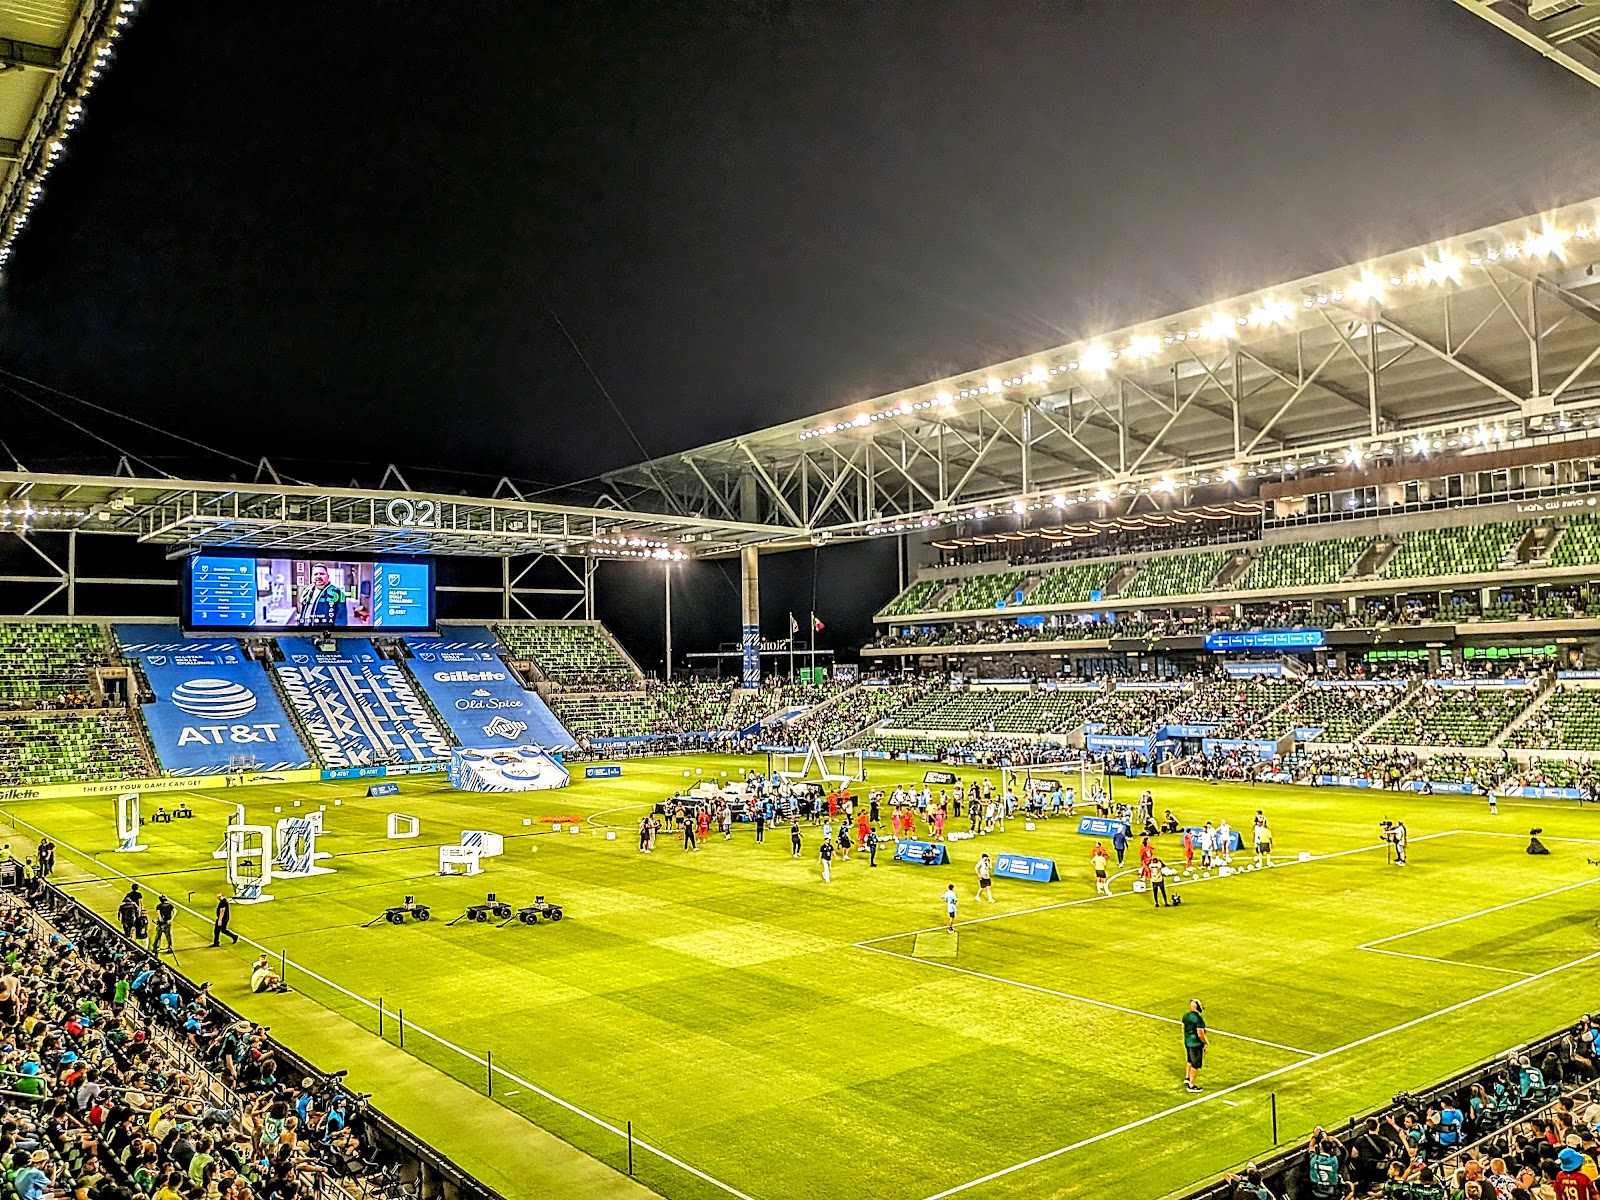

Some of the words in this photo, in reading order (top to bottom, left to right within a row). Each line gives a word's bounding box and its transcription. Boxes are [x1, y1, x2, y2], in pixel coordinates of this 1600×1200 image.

[386, 498, 434, 526] Q2
[433, 670, 506, 682] Gillette
[455, 698, 484, 710] Old
[486, 697, 523, 710] Spice
[177, 723, 280, 746] AT&T
[482, 719, 528, 738] Bounty
[144, 781, 167, 789] GAME
